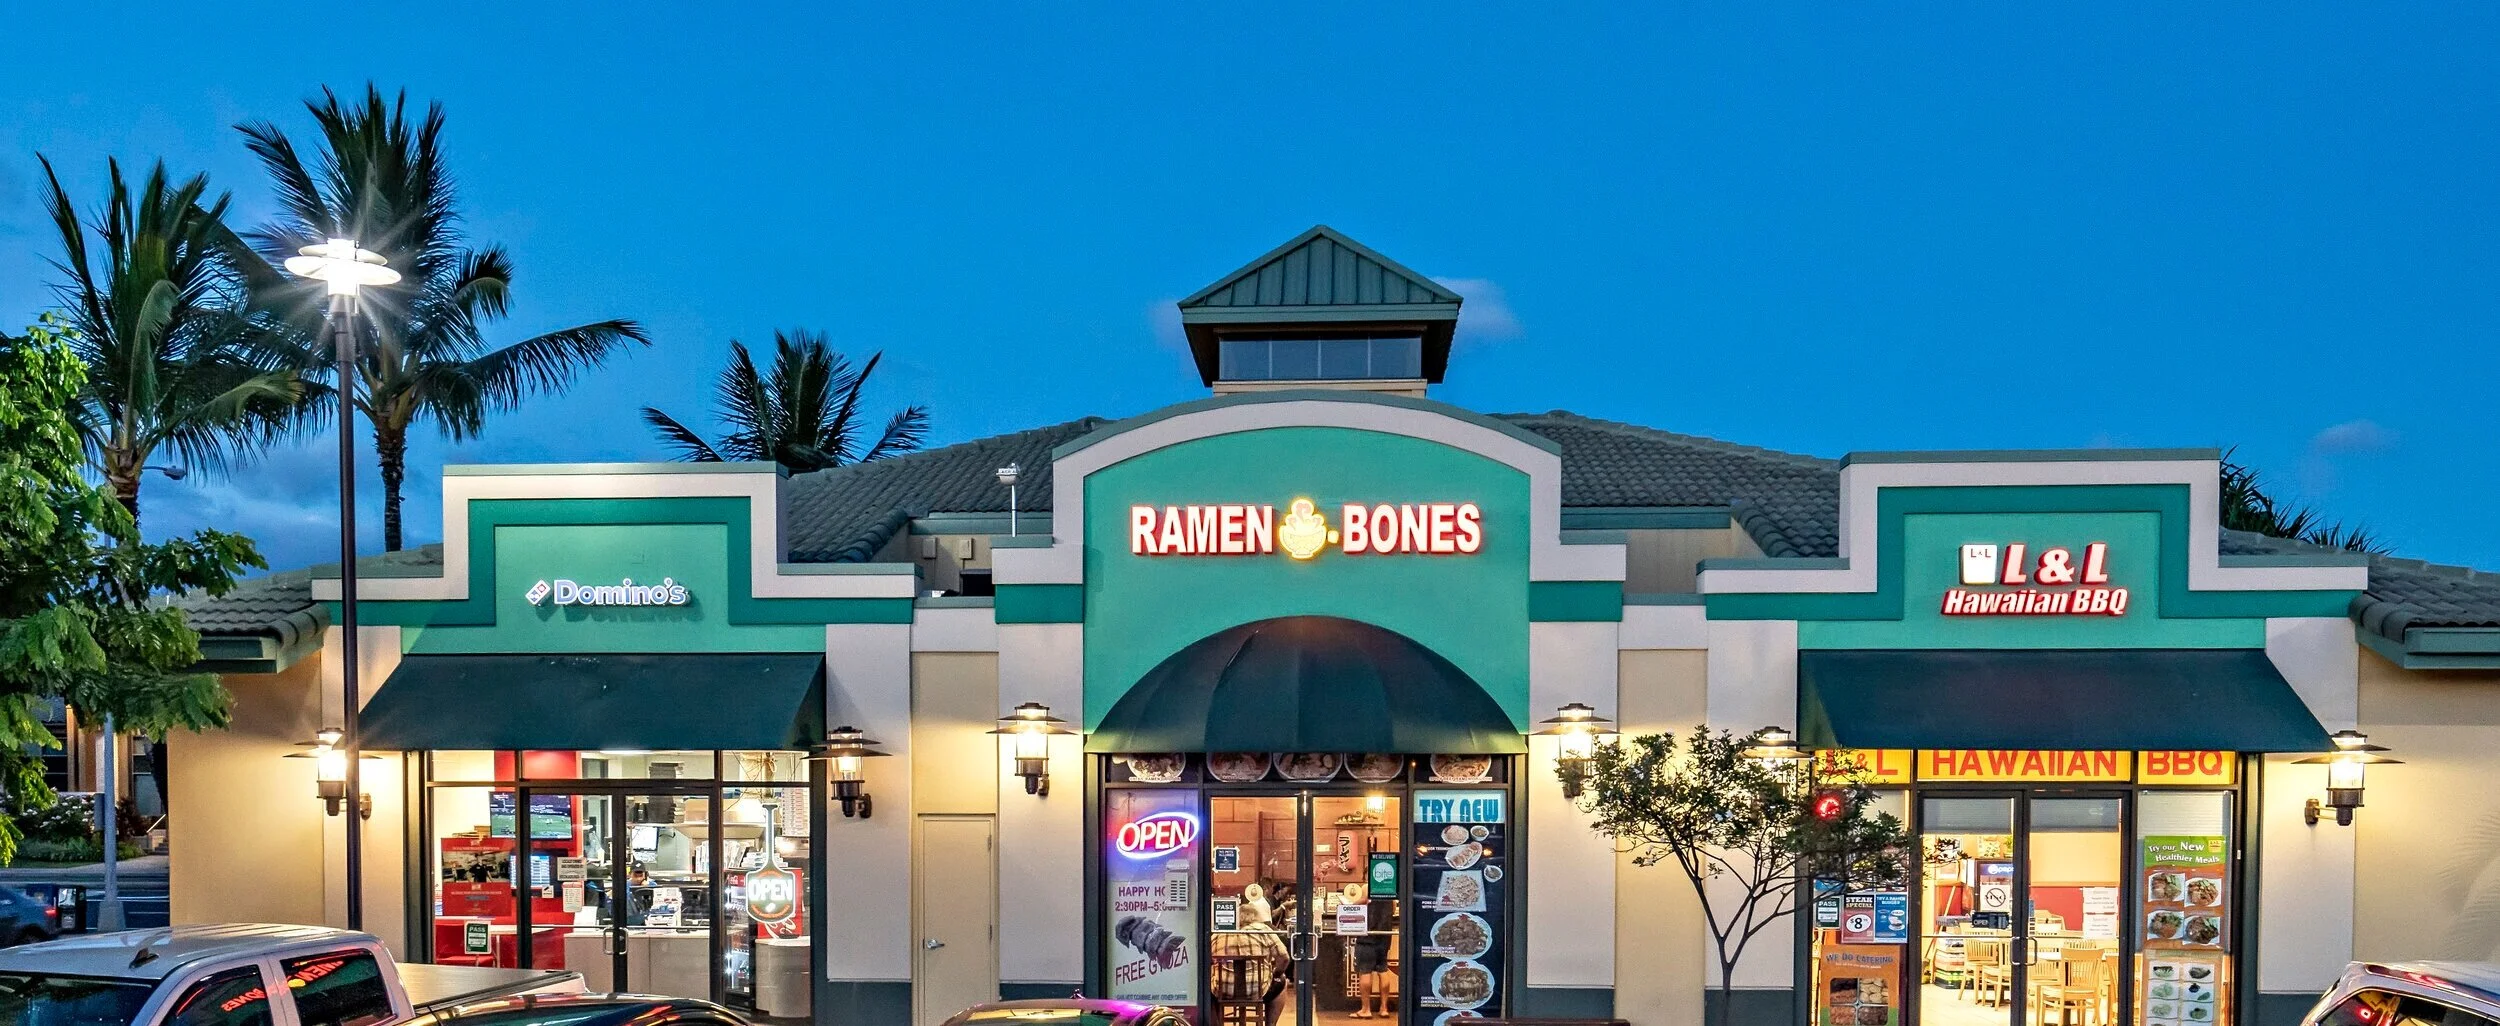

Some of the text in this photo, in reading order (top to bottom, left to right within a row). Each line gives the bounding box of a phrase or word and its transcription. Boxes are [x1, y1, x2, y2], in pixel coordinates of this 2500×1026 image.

[1131, 503, 1482, 554] RAMEN BONES
[2004, 543, 2108, 583] L & L
[554, 577, 685, 605] Domino's
[1944, 588, 2128, 615] Hawaiian BBQ
[1856, 753, 1868, 770] &
[1877, 749, 1898, 775] L
[1933, 750, 2223, 777] HAWAIIAN BBQ
[1419, 799, 1499, 822] TRY NEW
[1119, 818, 1191, 851] OPEN
[2148, 845, 2160, 853] Try
[2180, 841, 2205, 851] New
[1339, 836, 1350, 864] ラーメン
[2155, 853, 2220, 864] Healthier Meals
[747, 878, 794, 902] OPEN
[1118, 886, 1150, 897] HAPPY
[1826, 953, 1839, 962] WE
[1856, 954, 1893, 964] CATERING
[1115, 960, 1146, 986] FREE
